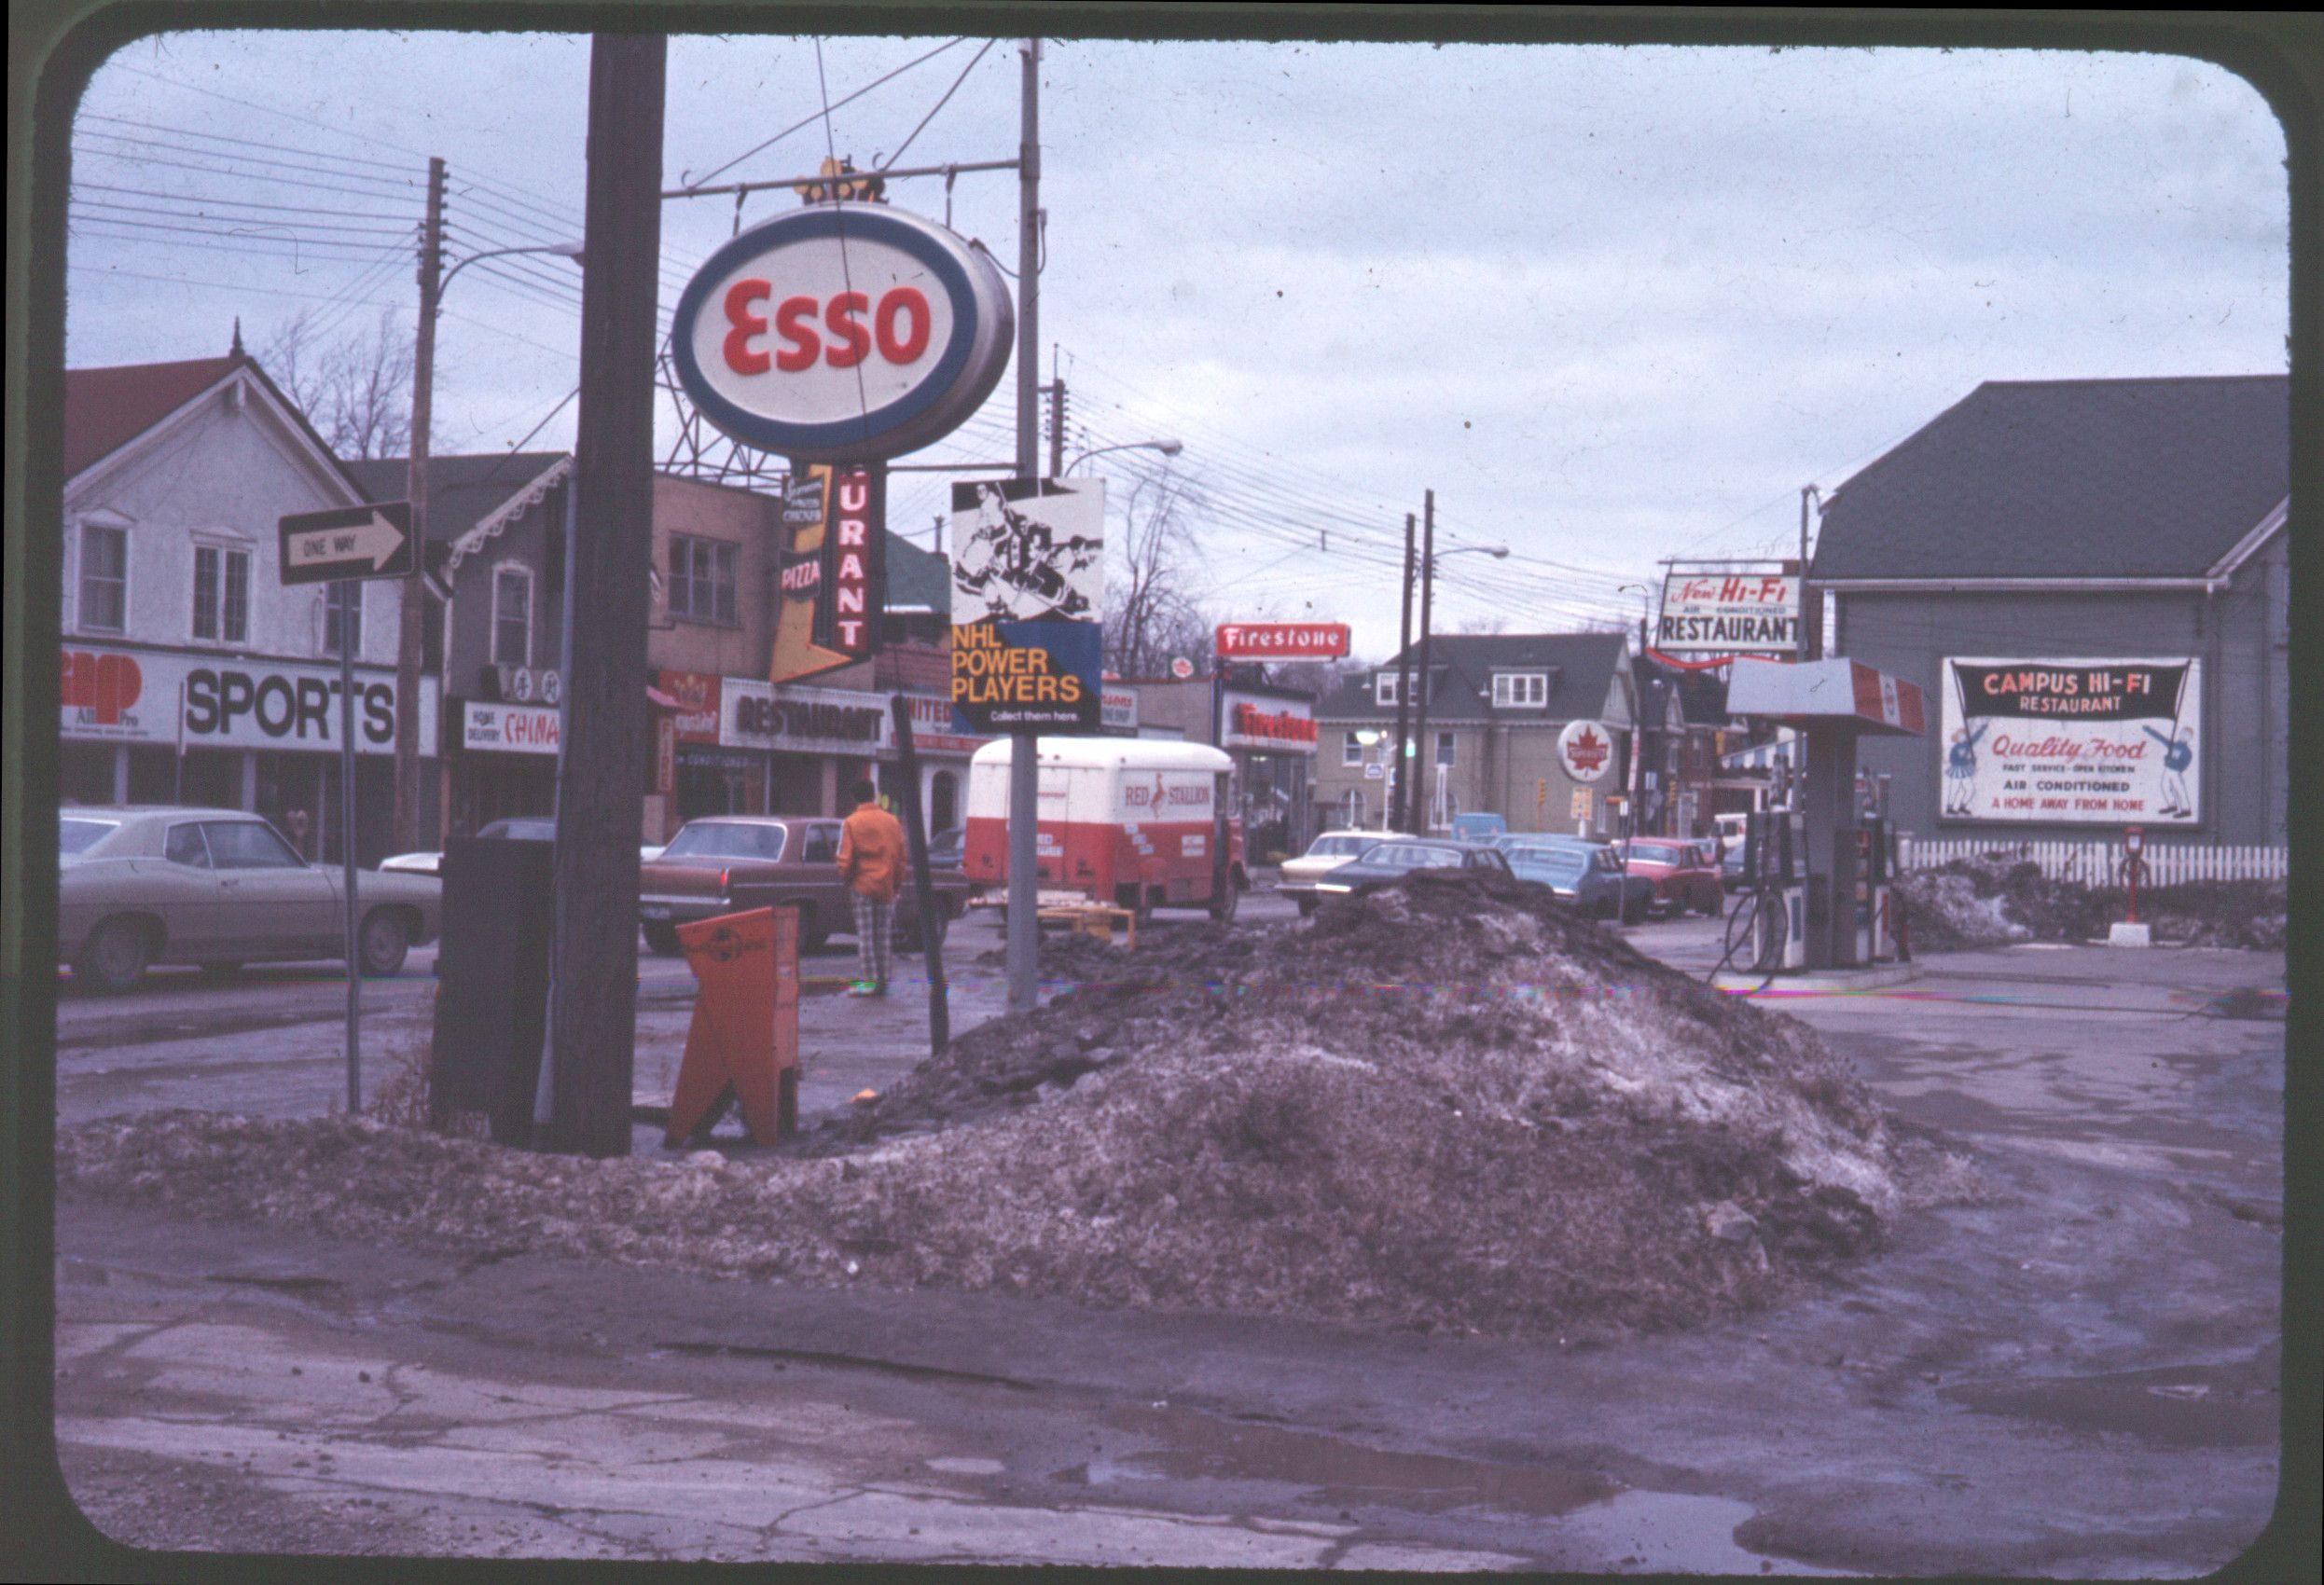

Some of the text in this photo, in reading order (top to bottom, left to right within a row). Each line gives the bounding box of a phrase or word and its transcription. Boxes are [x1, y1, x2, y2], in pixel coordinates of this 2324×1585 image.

[723, 279, 931, 377] Esso
[303, 534, 356, 557] ONE WAY
[838, 470, 867, 646] URANT
[782, 559, 820, 590] PIZZA
[1671, 578, 1717, 603] New
[1682, 606, 1786, 614] AIR CONDITIONED
[951, 623, 1002, 649] NHL
[1223, 627, 1339, 650] Firestone
[1662, 615, 1798, 642] RESTAURANT
[951, 647, 1049, 677] POWER
[951, 674, 1082, 704] PLAYERS
[1984, 671, 2151, 695] CAMPUS HI-FI
[905, 697, 951, 724] NITED
[990, 710, 1080, 722] Collect them here.
[2020, 696, 2122, 713] RESTAURANT
[505, 712, 560, 745] CHINA
[1992, 734, 2149, 764] Quality Food
[2003, 764, 2026, 773] FAST
[2031, 764, 2066, 773] SERVICE
[2072, 765, 2095, 773] OPEN
[1125, 785, 1210, 806] RED STALLION
[2004, 779, 2131, 792] AIR CONDITIONED
[1992, 797, 2144, 811] A HOME AWAY FROM HOME
